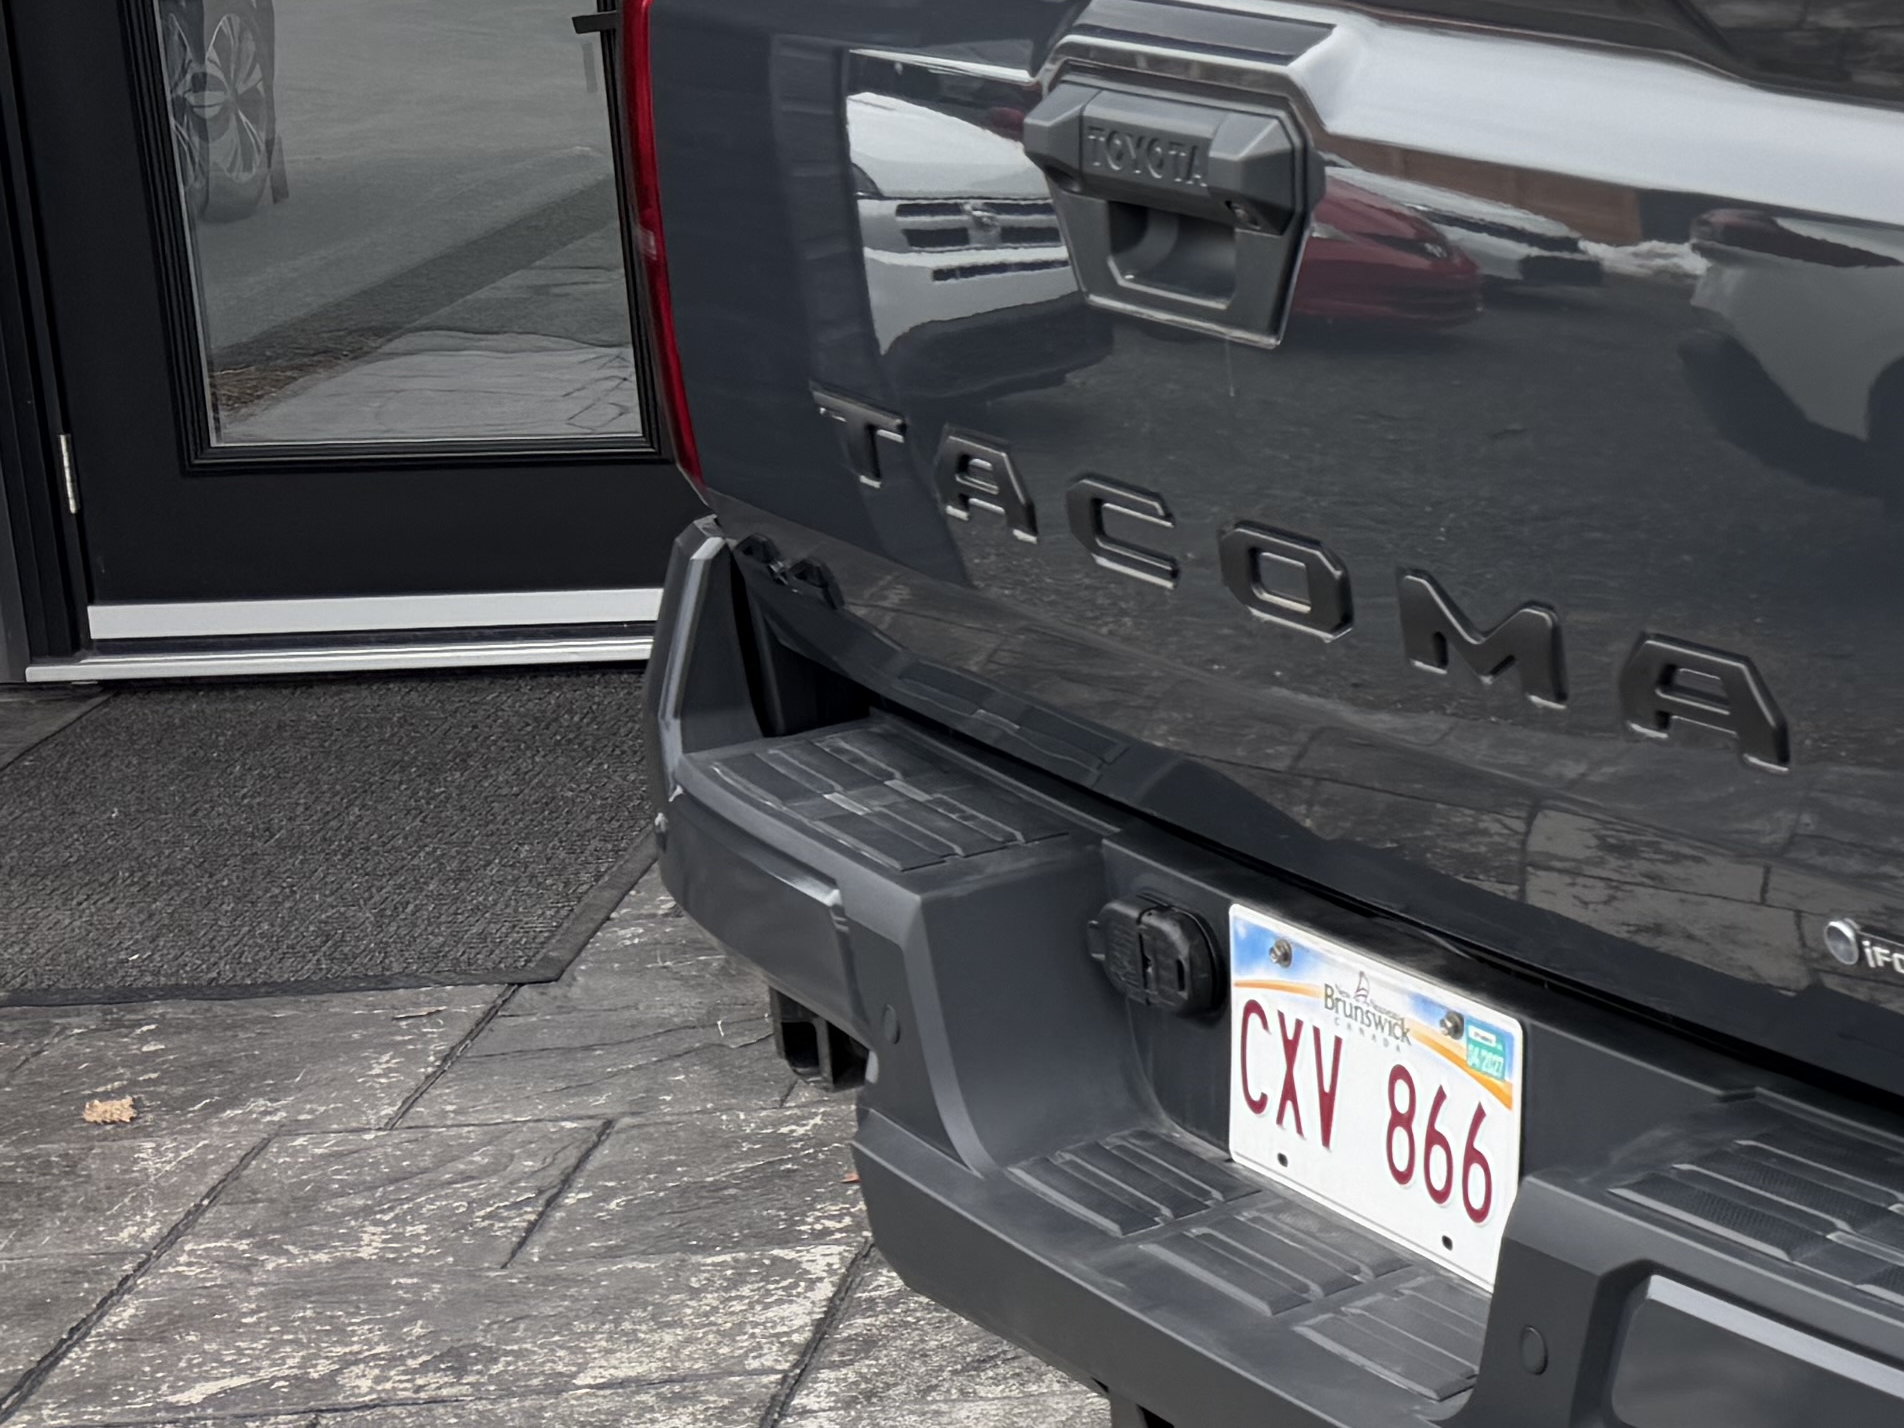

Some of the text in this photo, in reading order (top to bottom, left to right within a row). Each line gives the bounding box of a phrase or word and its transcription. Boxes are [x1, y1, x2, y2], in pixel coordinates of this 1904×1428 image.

[1087, 126, 1208, 188] TOYOTA
[811, 390, 1790, 773] TACOMA
[1323, 983, 1413, 1046] Brunswick
[1240, 999, 1493, 1225] CXV 866
